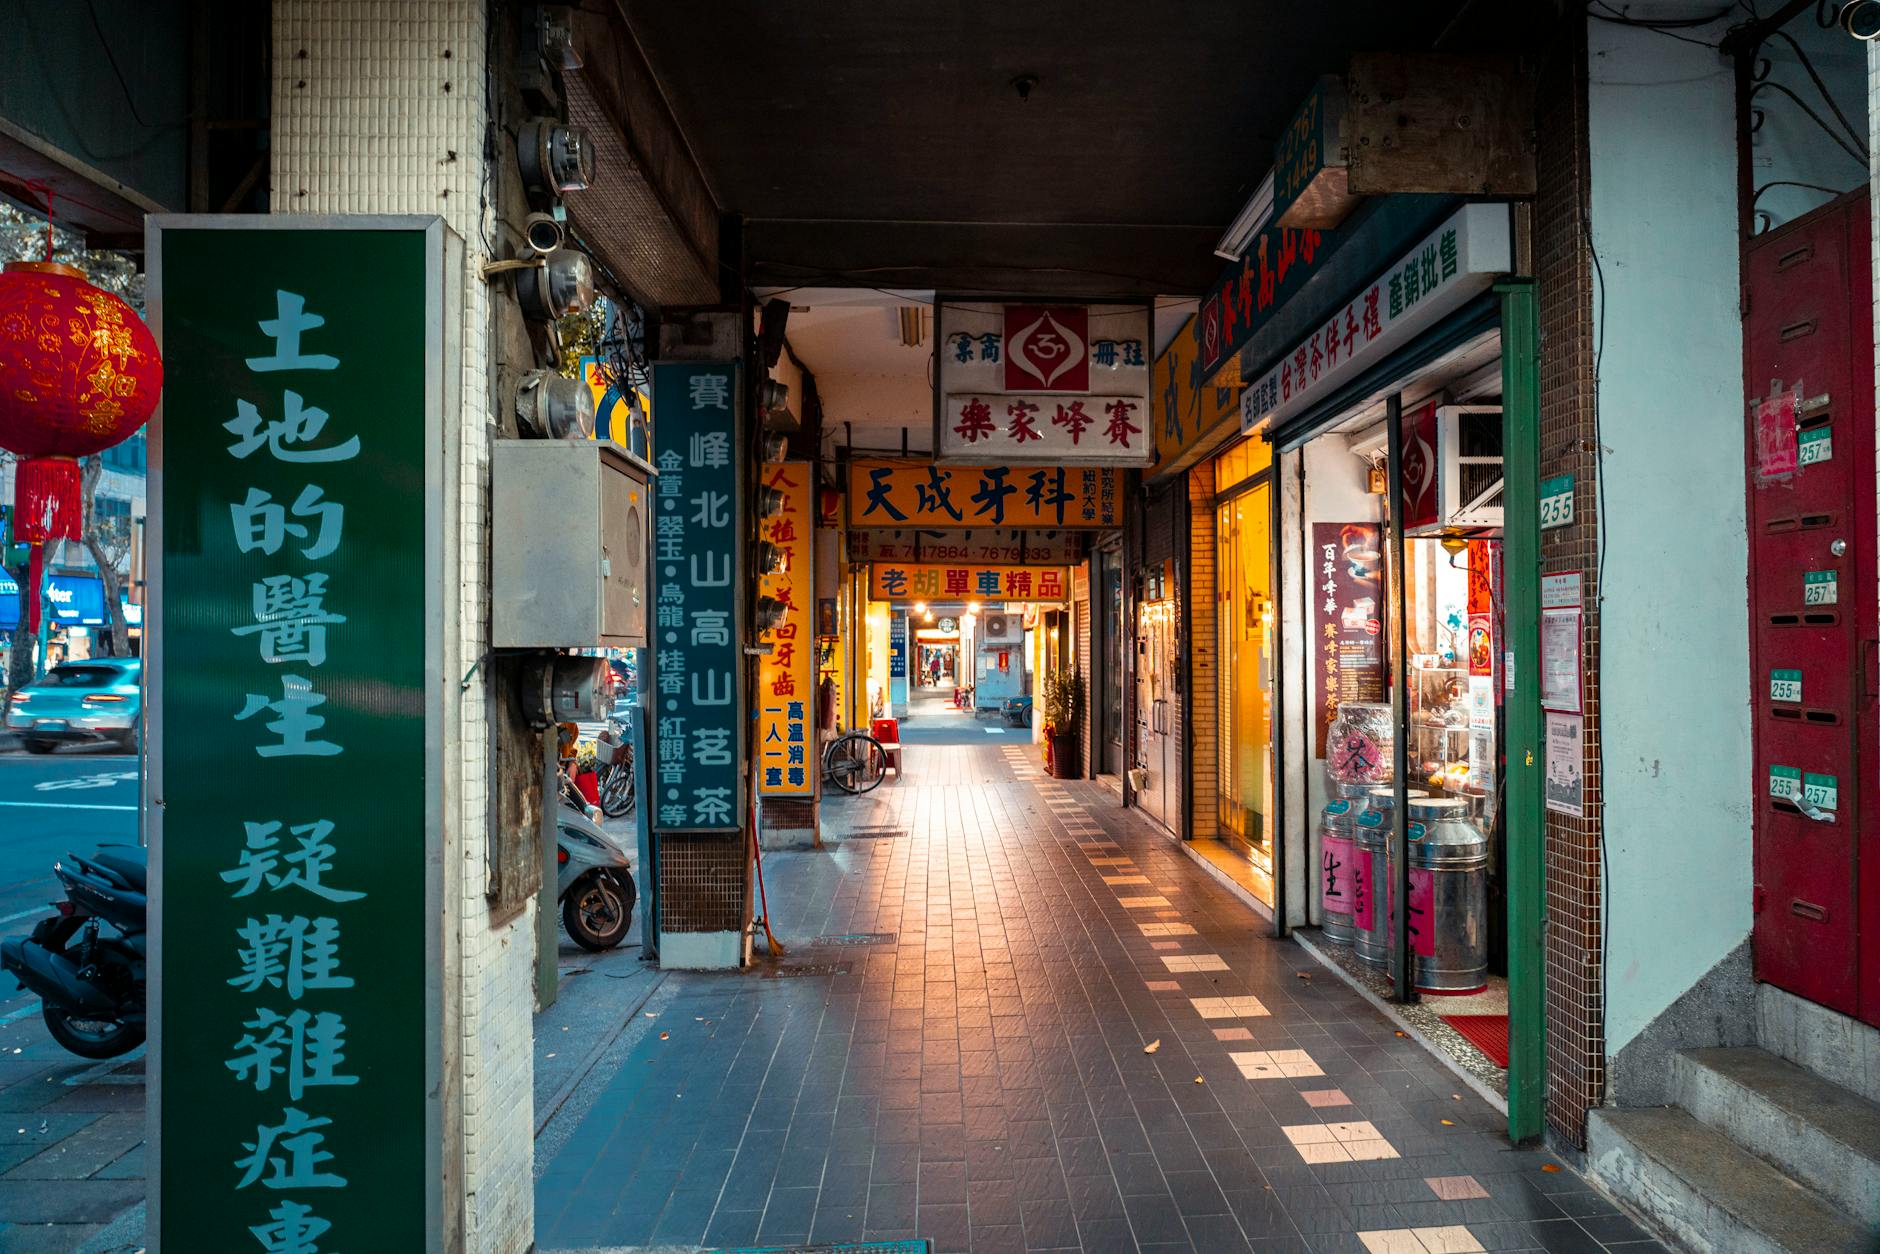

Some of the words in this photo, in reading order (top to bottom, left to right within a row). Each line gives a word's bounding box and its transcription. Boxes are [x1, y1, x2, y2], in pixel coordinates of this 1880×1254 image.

[1281, 285, 1382, 402] 台灣茶伴手禮
[1388, 228, 1458, 320] 產銷批售
[1800, 442, 1822, 462] 257
[862, 466, 1075, 524] 天成牙科
[1541, 495, 1572, 524] 255
[222, 288, 360, 758] 土地的醫生
[880, 568, 1062, 598] 老胡單車精品
[1806, 586, 1827, 603] 257
[689, 374, 732, 825] 賽峰北山高山茗茶
[1771, 682, 1793, 698] 255
[765, 707, 783, 787] 一人一套
[1771, 778, 1792, 795] 255
[1806, 787, 1828, 805] 257
[1323, 851, 1342, 896] 生
